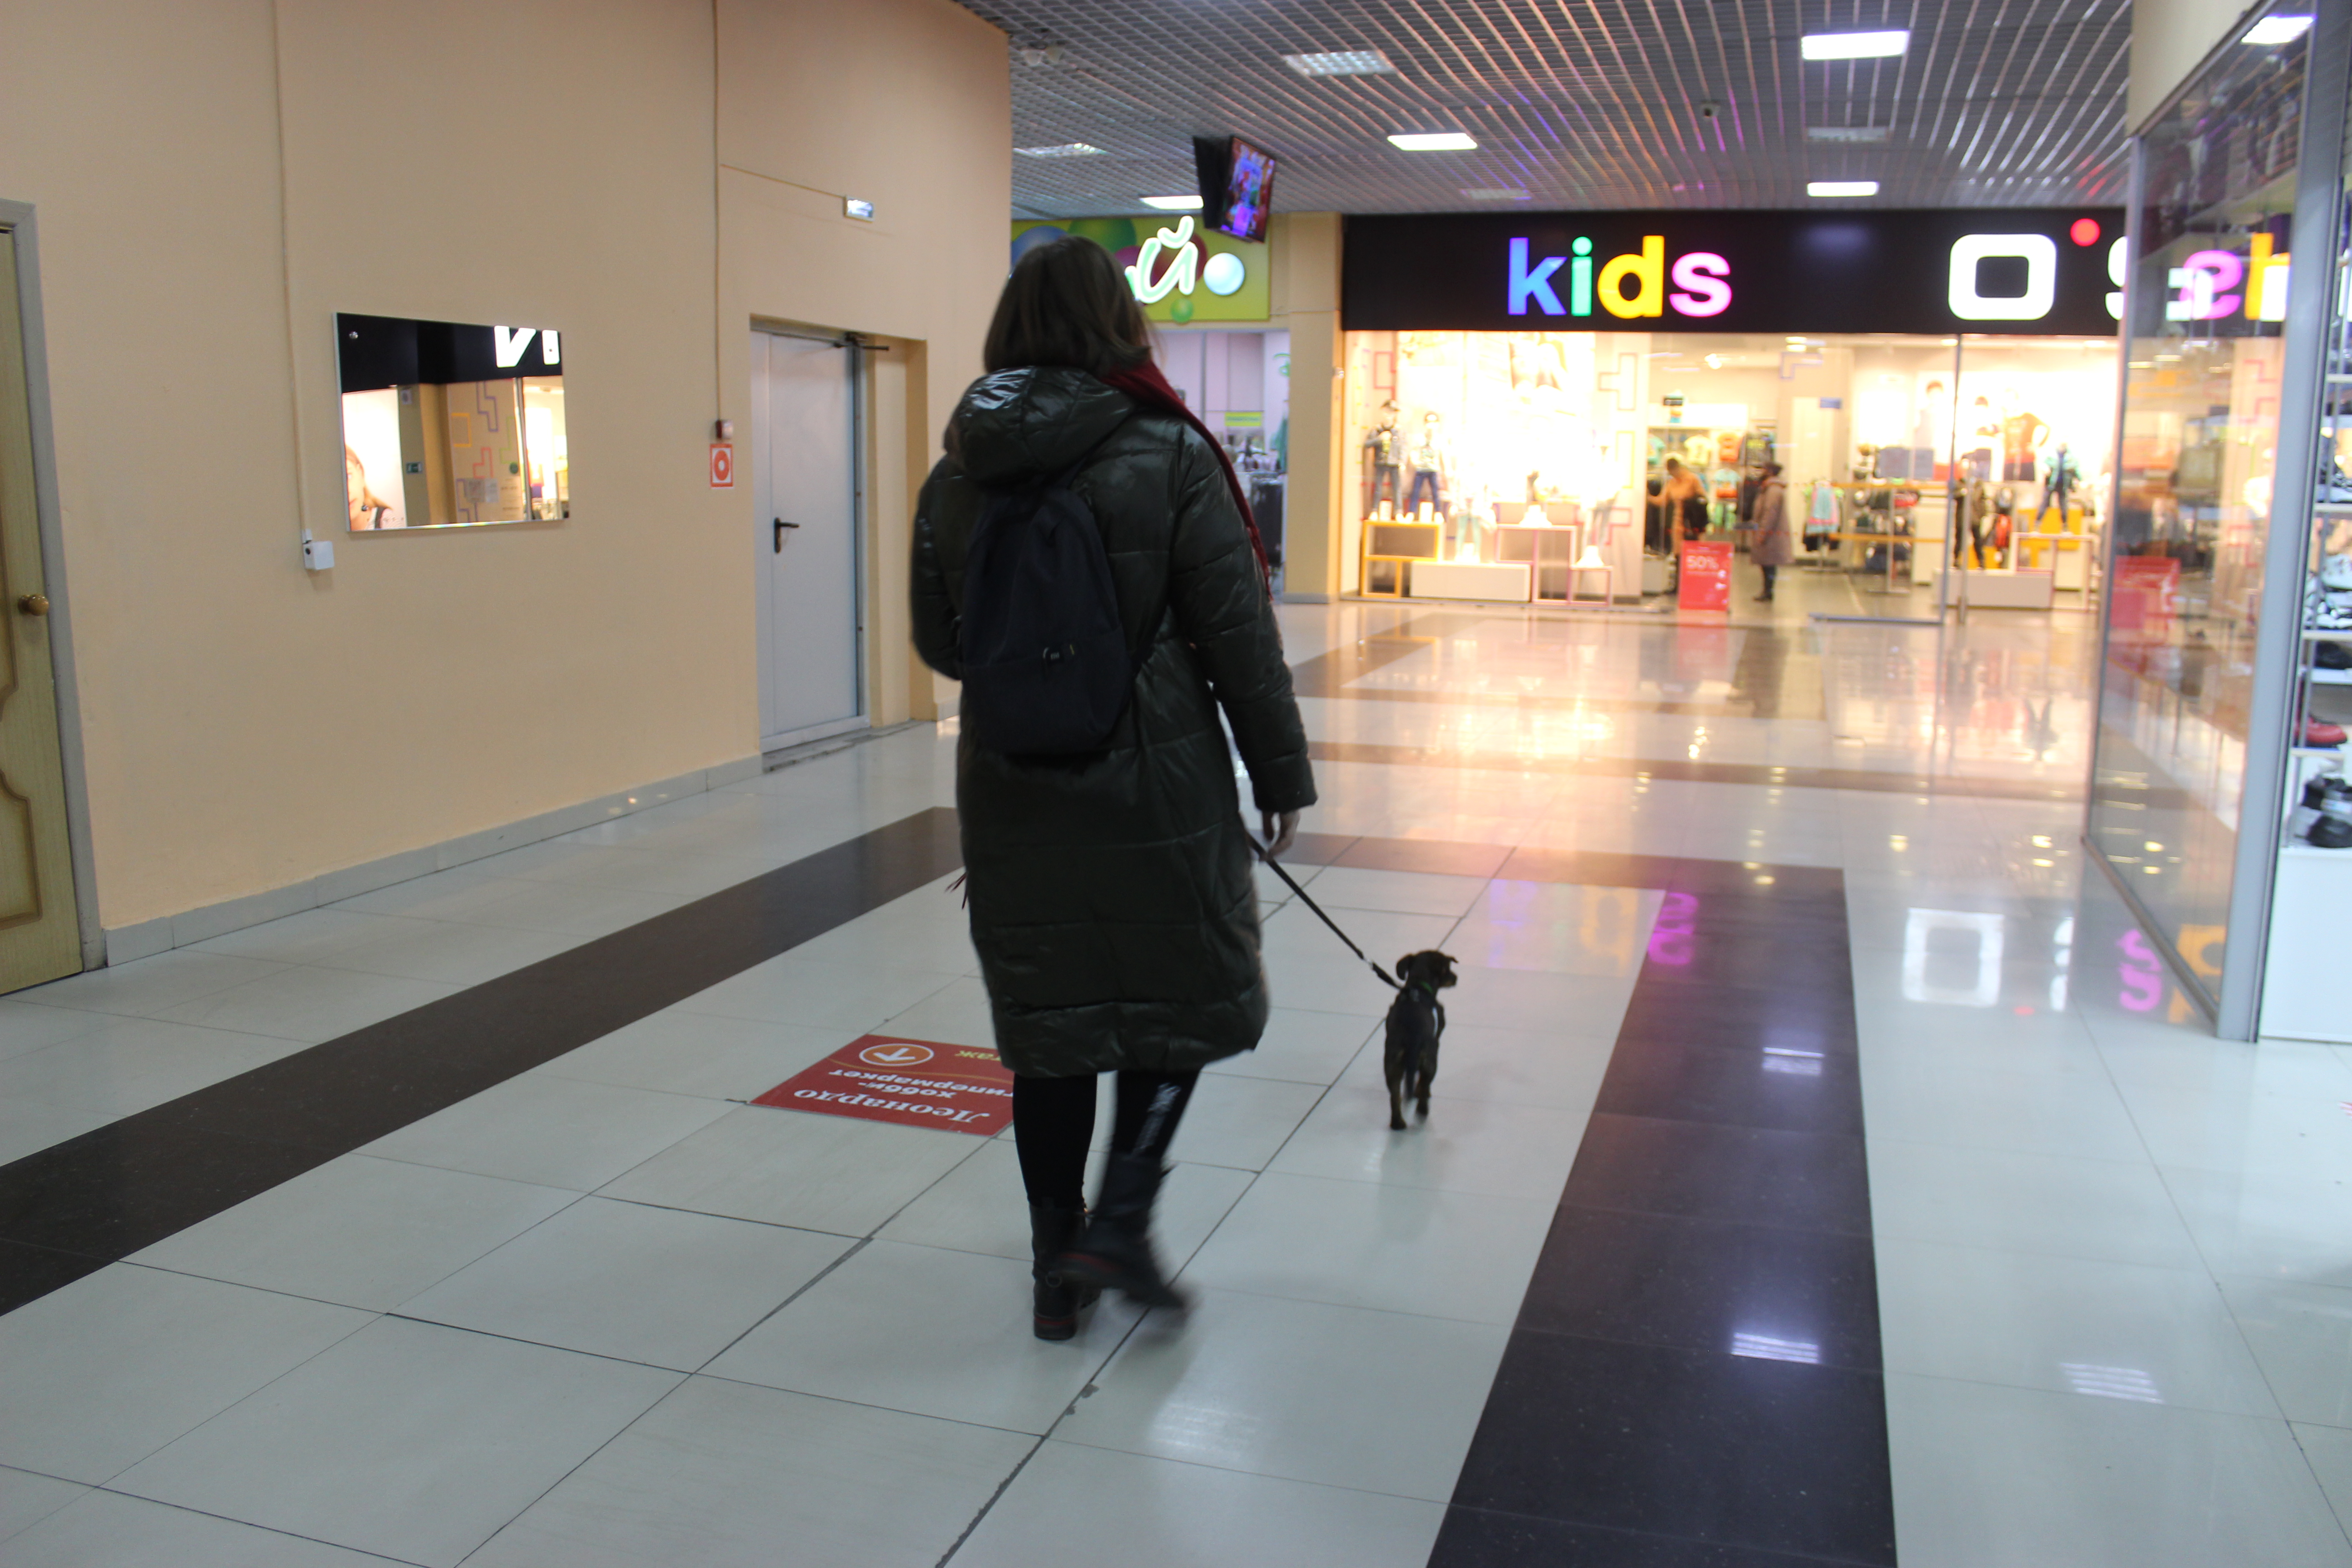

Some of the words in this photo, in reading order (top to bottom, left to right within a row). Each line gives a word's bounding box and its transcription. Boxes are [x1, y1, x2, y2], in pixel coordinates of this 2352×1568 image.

[1508, 235, 1732, 319] kids
[1686, 555, 1719, 570] 50%
[794, 1089, 990, 1123] Леонардо
